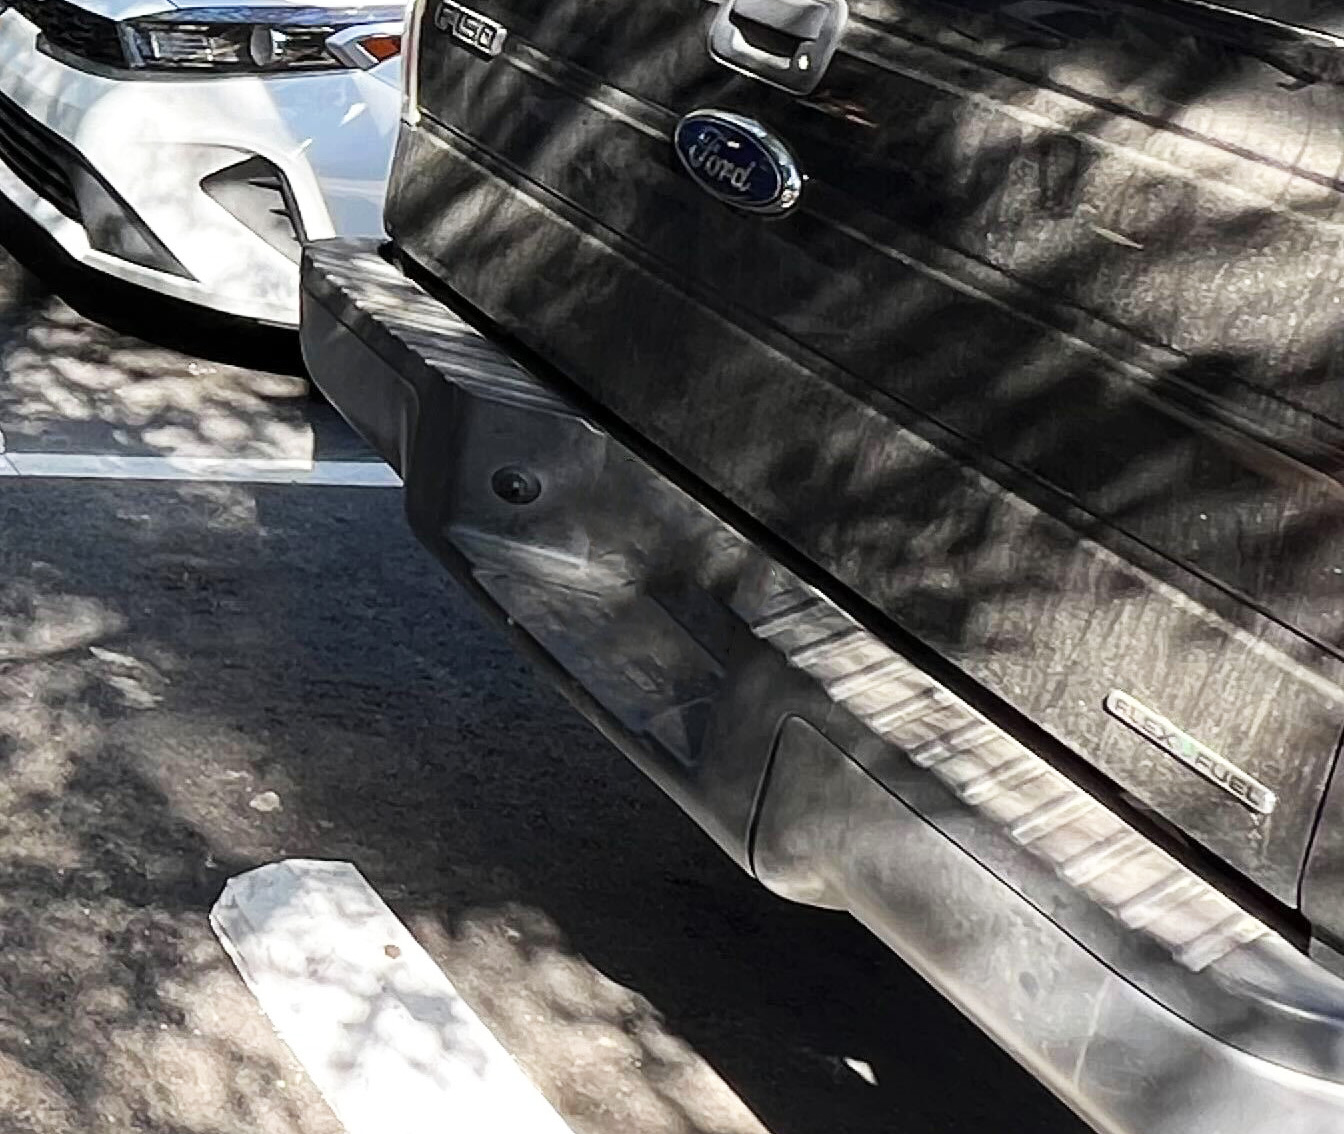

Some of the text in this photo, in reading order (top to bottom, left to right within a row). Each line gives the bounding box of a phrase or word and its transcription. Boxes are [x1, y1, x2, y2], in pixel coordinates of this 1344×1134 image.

[687, 125, 758, 192] Ford
[1114, 698, 1260, 806] FLEX FUEL
